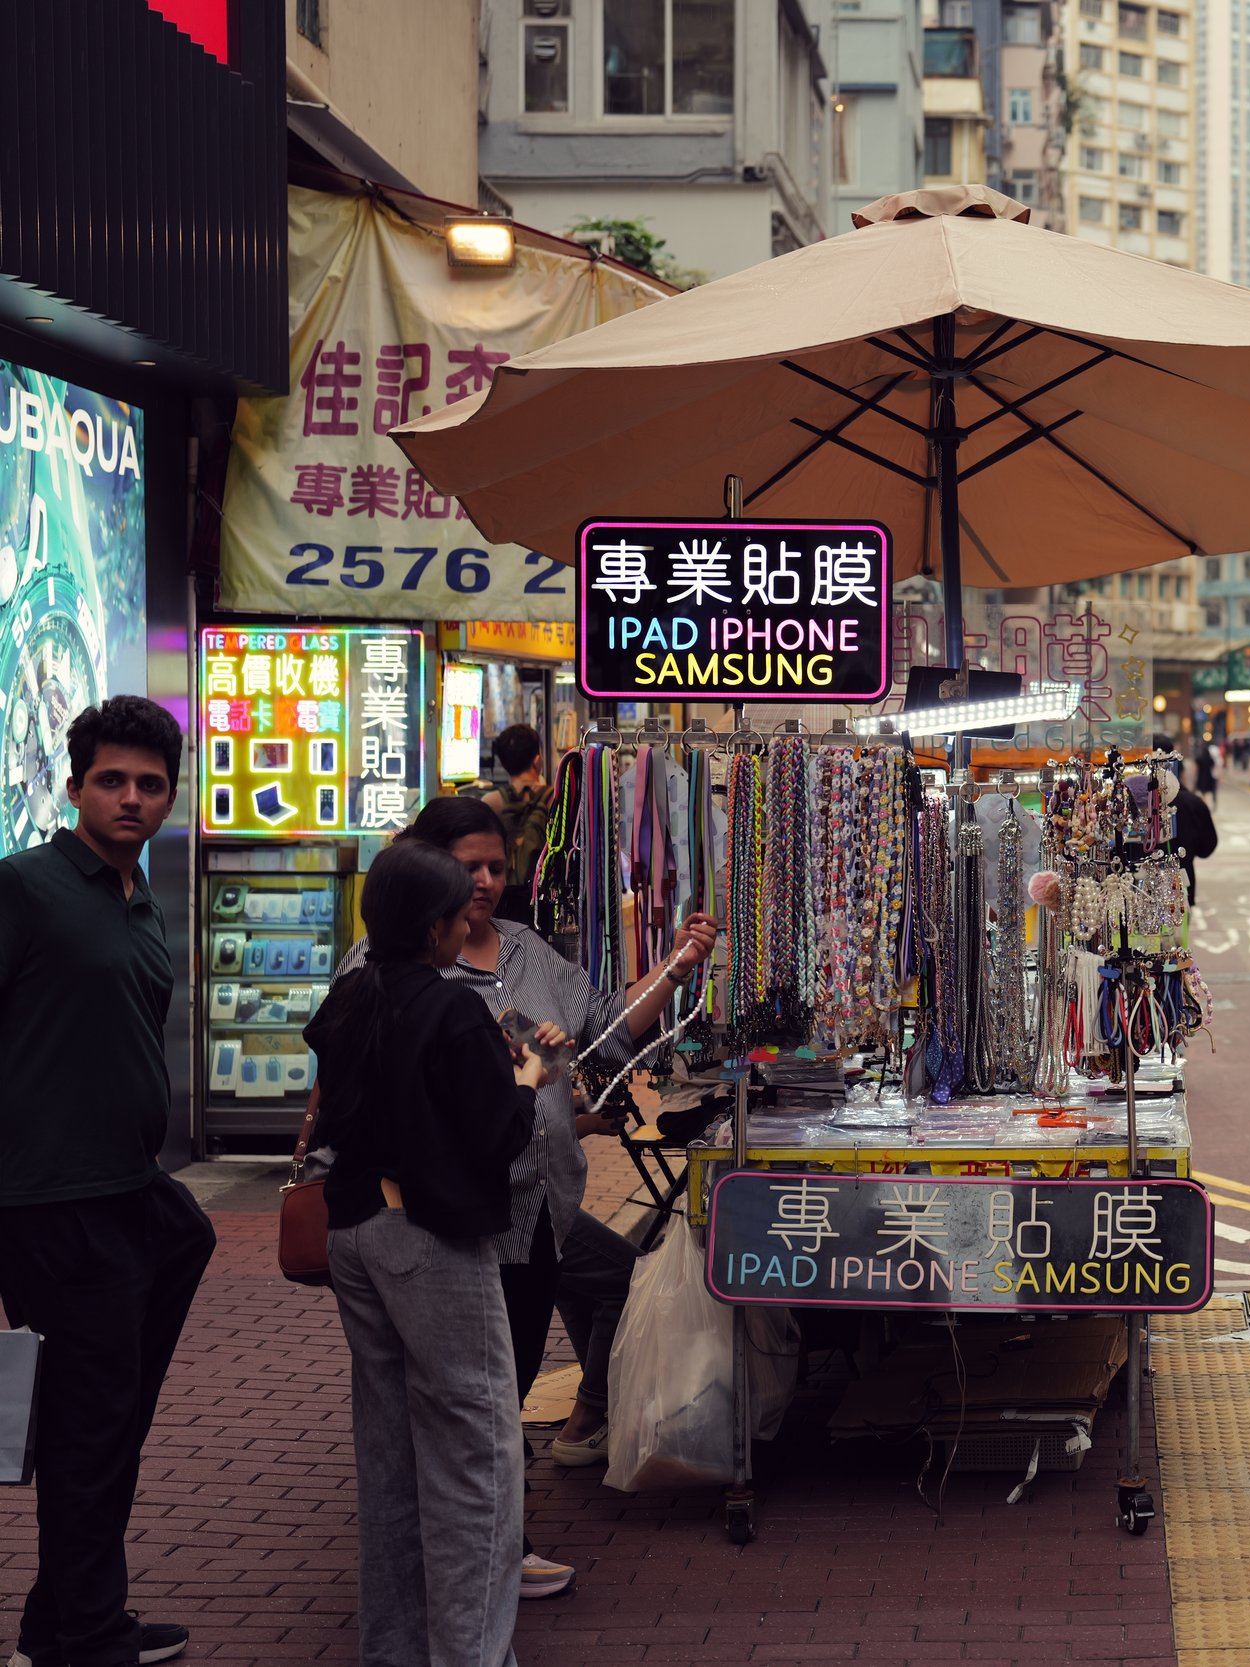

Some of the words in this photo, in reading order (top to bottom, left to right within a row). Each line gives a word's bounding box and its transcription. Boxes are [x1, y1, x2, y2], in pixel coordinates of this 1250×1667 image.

[290, 463, 473, 521] 專業貼
[285, 542, 490, 594] 2576
[592, 538, 878, 607] 專業貼膜
[207, 634, 286, 650] TEMPERED
[289, 635, 339, 650] GLASS
[608, 617, 699, 651] IPAD
[710, 618, 859, 652] IPHONE
[207, 652, 340, 697] 高價收機
[635, 653, 833, 686] SAMSUNG
[360, 636, 409, 829] 專業貼膜
[1045, 724, 1138, 753] Glass
[766, 1178, 1164, 1261] 專業貼膜
[727, 1252, 817, 1288] IPAD
[830, 1257, 979, 1292] IPHONE
[992, 1261, 1191, 1294] SAMSUNG
